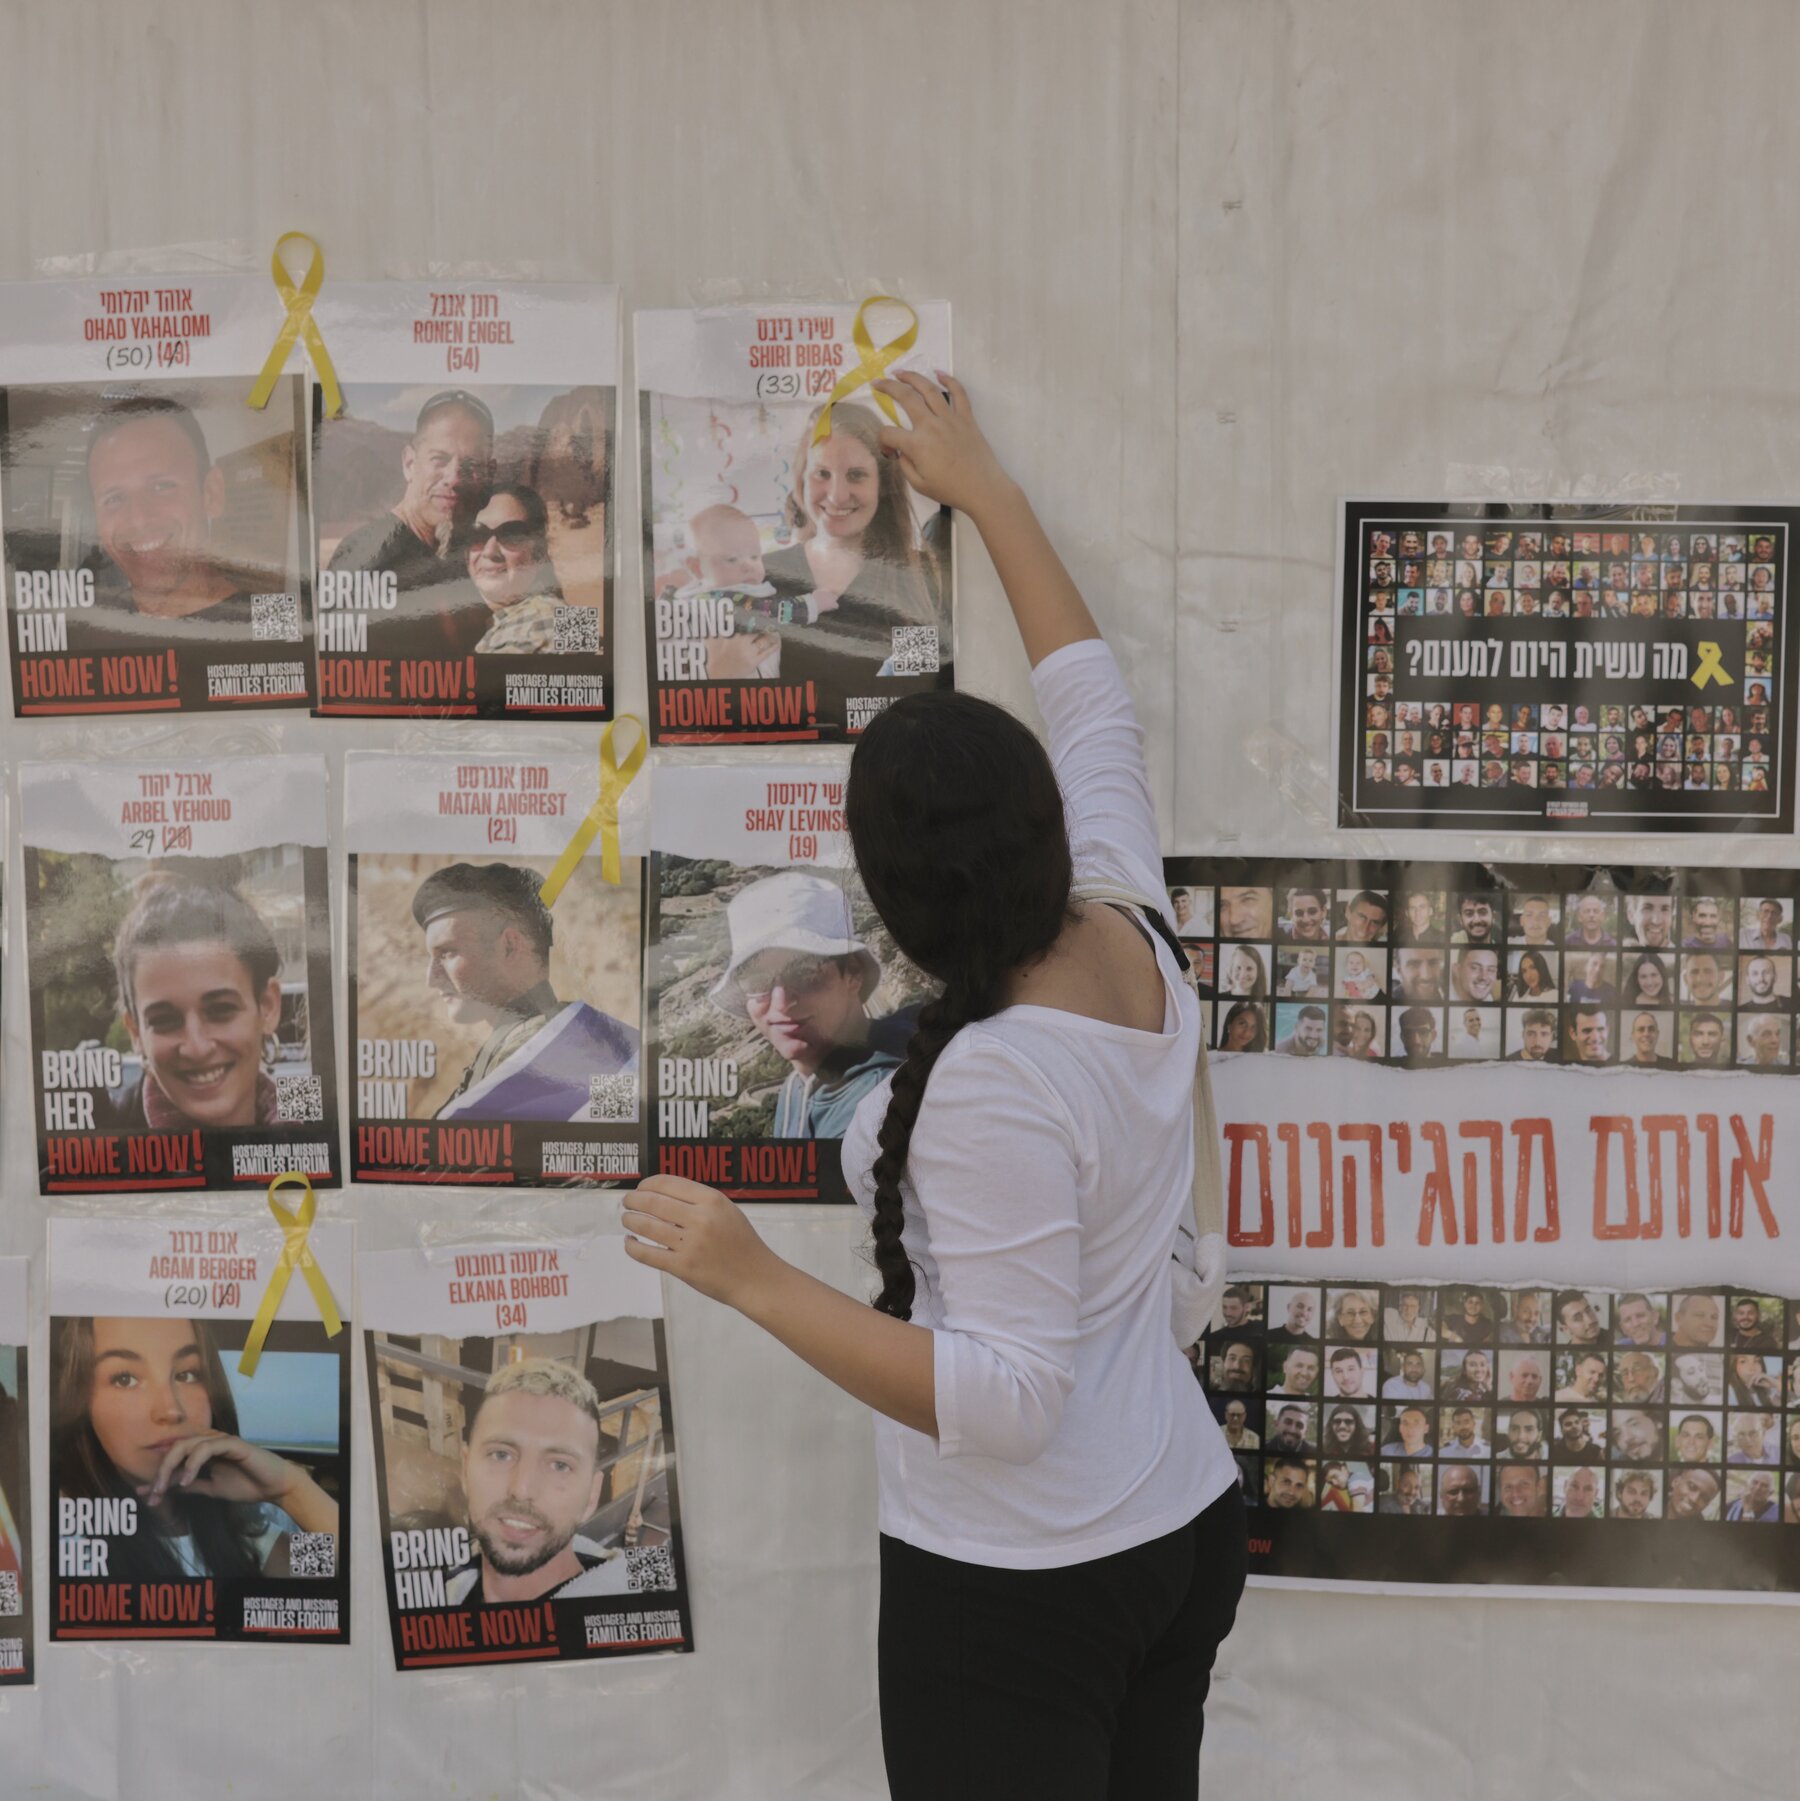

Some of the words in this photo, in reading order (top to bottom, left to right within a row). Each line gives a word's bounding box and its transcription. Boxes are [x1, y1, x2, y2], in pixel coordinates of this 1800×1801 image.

[100, 290, 149, 314] יהלומי
[154, 288, 192, 312] אוהד
[430, 293, 465, 317] אנגל
[470, 294, 498, 319] רונן
[84, 318, 127, 341] OHAD
[131, 314, 210, 339] YAHALOMI
[413, 320, 463, 343] RONEN
[468, 320, 514, 344] ENGEL
[757, 318, 793, 341] ביבס
[798, 317, 834, 340] שירי
[106, 345, 152, 370] (50)
[447, 345, 480, 373] (54)
[749, 345, 791, 368] SHIRI
[796, 343, 843, 367] BIBAS
[756, 373, 800, 398] (33)
[15, 568, 95, 610] BRING
[318, 570, 397, 610] BRING
[655, 597, 735, 639] BRING
[17, 612, 68, 653] HIM
[319, 613, 367, 652] HIM
[207, 664, 249, 678] HOSTAGES
[250, 663, 267, 676] AND
[268, 662, 305, 675] MISSING
[656, 641, 708, 681] HER
[1405, 637, 1504, 678] למענם?
[1510, 641, 1567, 679] היום
[1573, 641, 1646, 679] עשית
[1652, 642, 1689, 680] מה
[20, 658, 95, 698] HOME
[101, 648, 178, 696] NOW!
[320, 658, 392, 698] HOME
[400, 656, 476, 699] NOW!
[505, 674, 547, 687] HOSTAGES
[548, 674, 565, 687] AND
[566, 675, 603, 688] MISSING
[208, 677, 261, 697] FAMILIES
[263, 675, 306, 694] FORUM
[505, 687, 558, 706] FAMILIES
[561, 688, 603, 706] FORUM
[659, 688, 733, 727] HOME
[740, 680, 817, 725] NOW!
[138, 774, 170, 797] יהוד
[175, 772, 212, 796] ארבל
[457, 766, 515, 789] אנגרסט
[520, 766, 549, 791] מתן
[439, 792, 492, 815] MATAN
[496, 793, 567, 816] ANGREST
[767, 782, 817, 807] לוינסון
[822, 783, 842, 805] שי
[121, 801, 169, 824] ARBEL
[173, 799, 231, 822] YEHOUD
[745, 809, 785, 832] SHAY
[129, 829, 155, 854] 29
[488, 817, 517, 844] (21)
[789, 834, 818, 861] (19)
[42, 1048, 122, 1089] BRING
[357, 1039, 436, 1079] BRING
[658, 1057, 738, 1097] BRING
[44, 1091, 95, 1131] HER
[358, 1081, 407, 1120] HIM
[658, 1100, 708, 1138] HIM
[47, 1136, 121, 1175] HOME
[127, 1128, 204, 1173] NOW!
[232, 1144, 273, 1158] HOSTAGES
[275, 1143, 291, 1157] AND
[292, 1143, 329, 1157] MISSING
[358, 1126, 430, 1165] HOME
[438, 1123, 512, 1167] NOW!
[542, 1141, 584, 1155] HOSTAGES
[585, 1142, 601, 1155] AND
[602, 1142, 638, 1156] MISSING
[233, 1157, 285, 1176] FAMILIES
[287, 1156, 330, 1174] FORUM
[543, 1155, 594, 1173] FAMILIES
[597, 1156, 639, 1174] FORUM
[659, 1145, 733, 1183] HOME
[741, 1141, 817, 1183] NOW!
[1223, 1116, 1561, 1249] מהגיהנום
[1589, 1113, 1780, 1241] אותם
[169, 1231, 203, 1254] ברגר
[208, 1231, 238, 1254] אגם
[149, 1255, 195, 1279] AGAM
[199, 1257, 257, 1280] BERGER
[455, 1252, 506, 1277] בוחבוט
[510, 1248, 559, 1274] אלקנה
[165, 1284, 207, 1309] (20)
[449, 1279, 507, 1304] ELKANA
[510, 1274, 569, 1300] BOHBOT
[496, 1301, 527, 1330] (34)
[59, 1497, 137, 1536] BRING
[59, 1538, 109, 1577] HER
[391, 1526, 471, 1570] BRING
[59, 1583, 132, 1622] HOME
[139, 1579, 214, 1622] NOW!
[395, 1569, 446, 1610] HIM
[243, 1597, 284, 1610] HOSTAGES
[285, 1597, 302, 1611] AND
[303, 1598, 339, 1612] MISSING
[244, 1610, 295, 1629] FAMILIES
[297, 1611, 339, 1630] FORUM
[400, 1612, 475, 1651] HOME
[480, 1602, 557, 1646] NOW!
[584, 1613, 625, 1627] HOSTAGES
[626, 1612, 643, 1624] AND
[643, 1609, 680, 1623] MISSING
[586, 1624, 638, 1645] FAMILIES
[640, 1622, 682, 1641] FORUM
